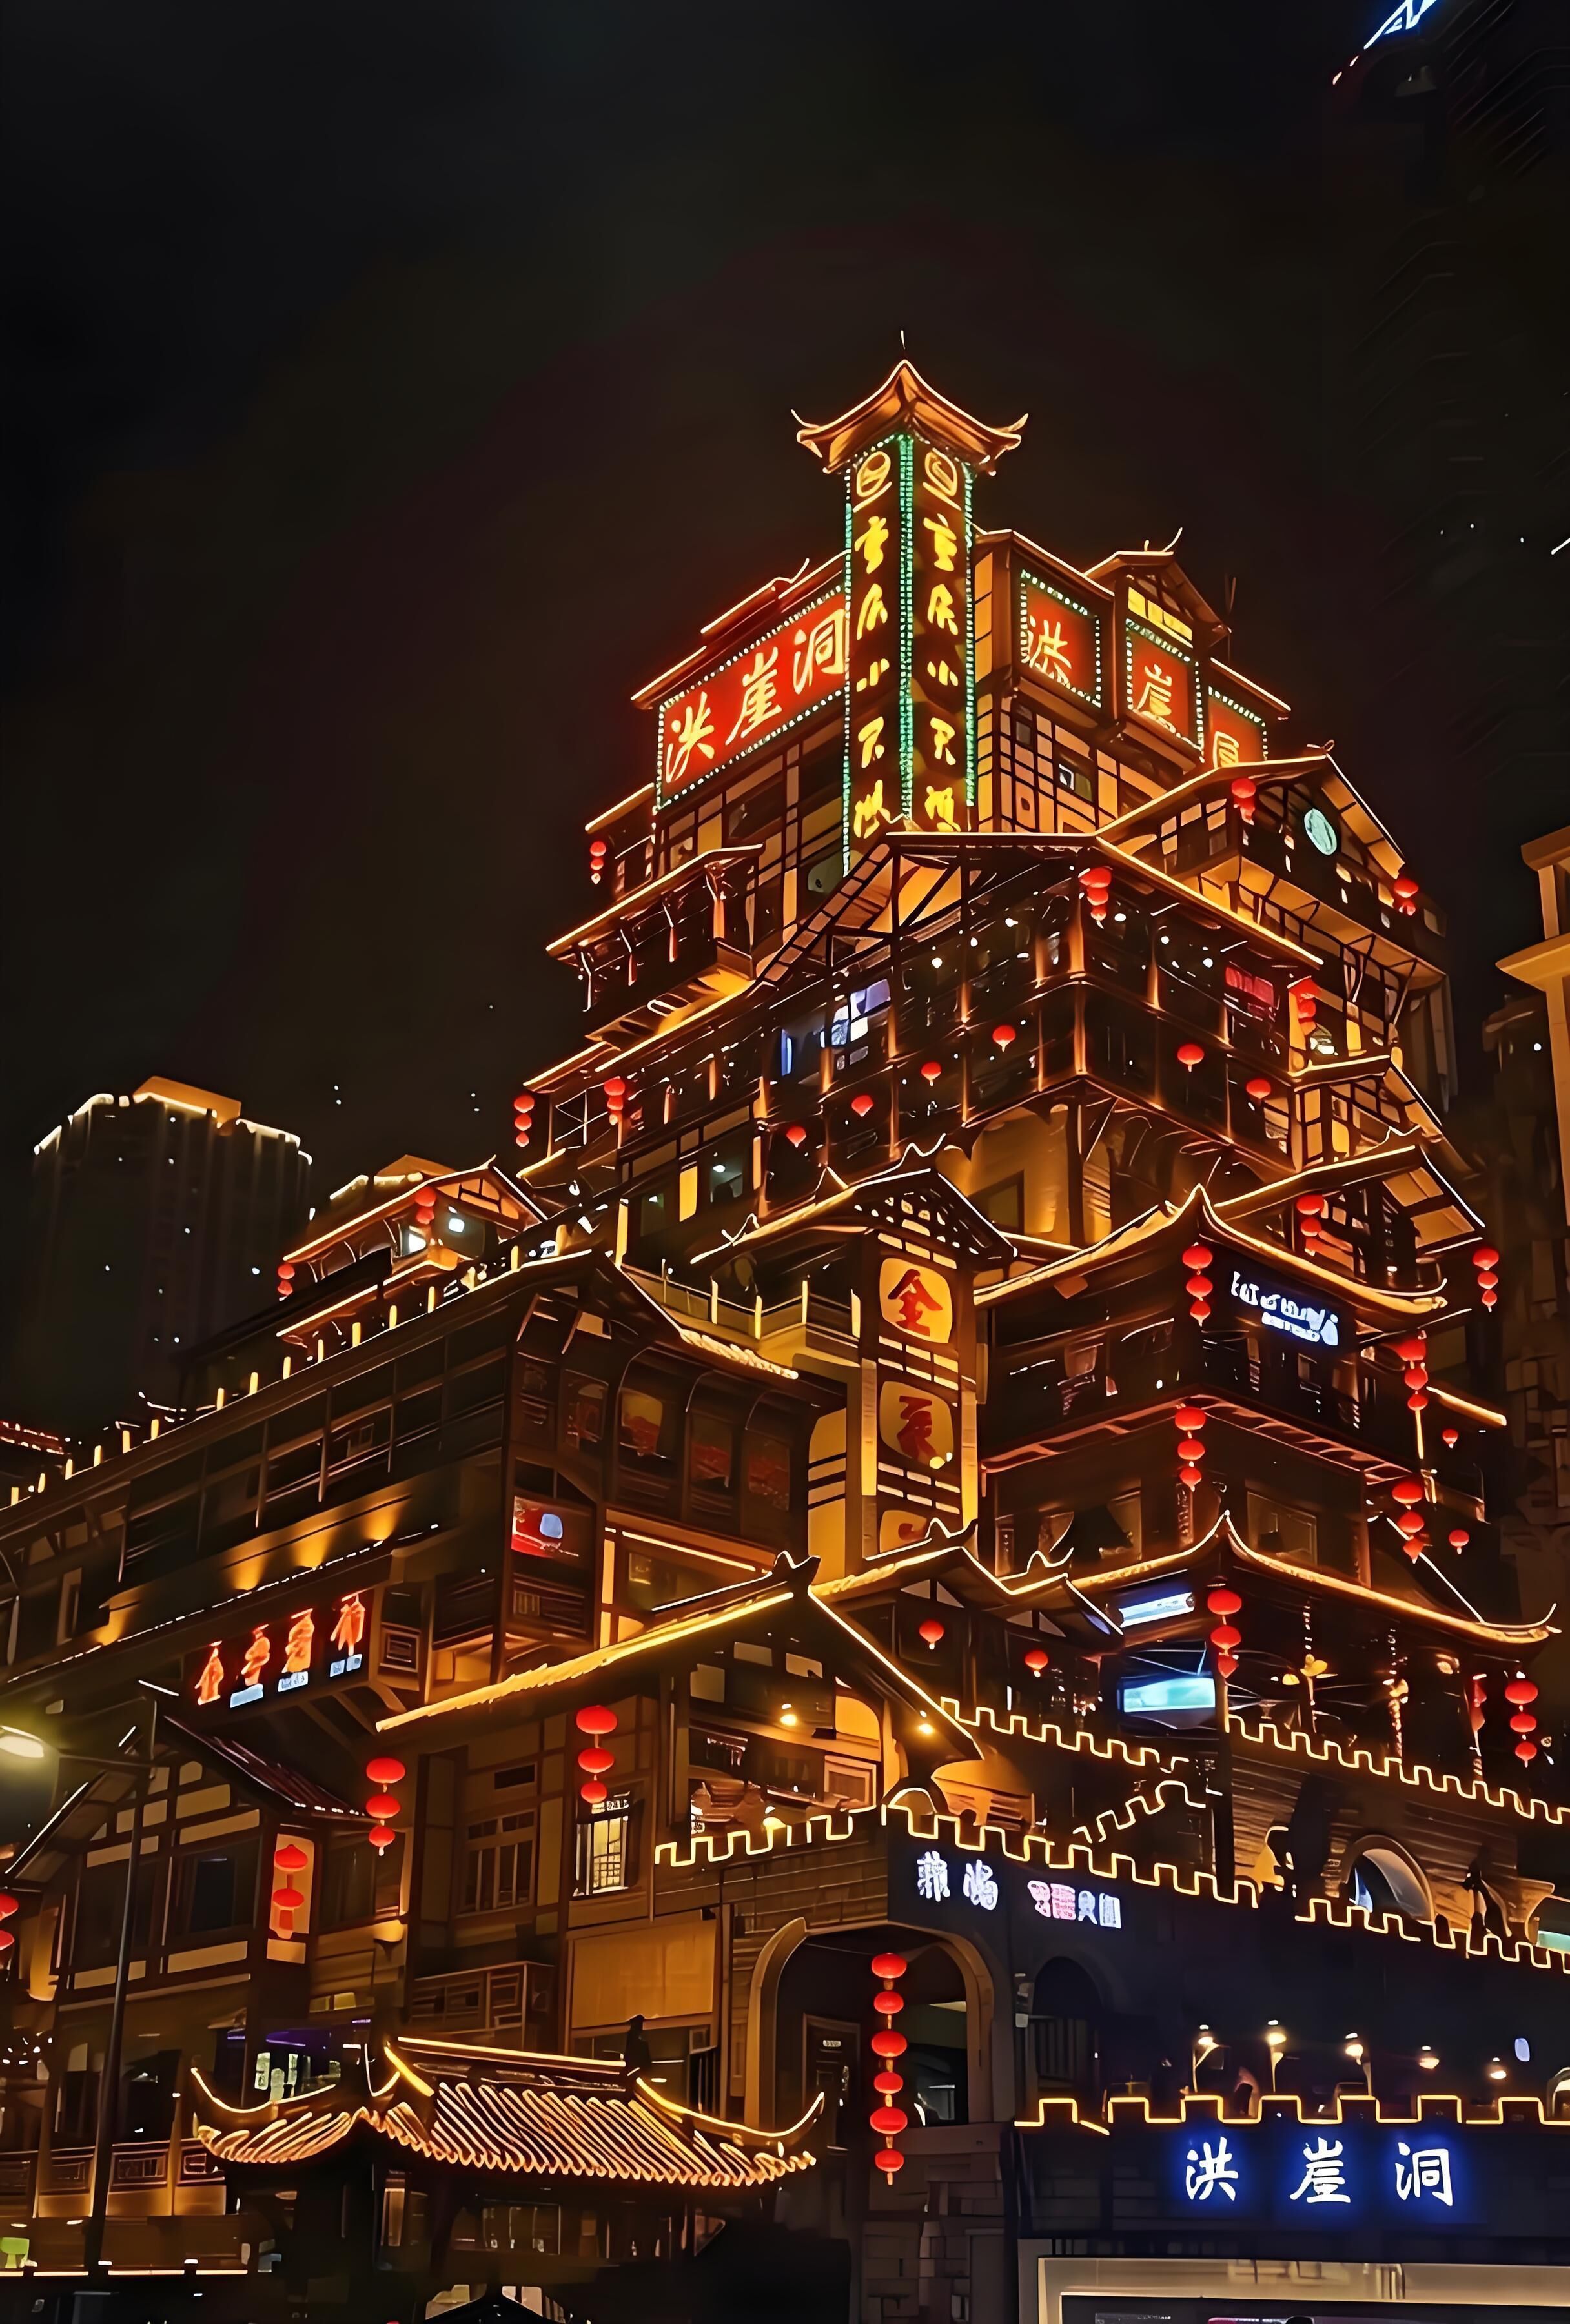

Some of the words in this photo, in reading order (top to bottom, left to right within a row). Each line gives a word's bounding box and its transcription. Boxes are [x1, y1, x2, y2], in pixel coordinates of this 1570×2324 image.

[665, 609, 846, 783] 洪崖洞
[1185, 2136, 1454, 2207] 洪崖洞
